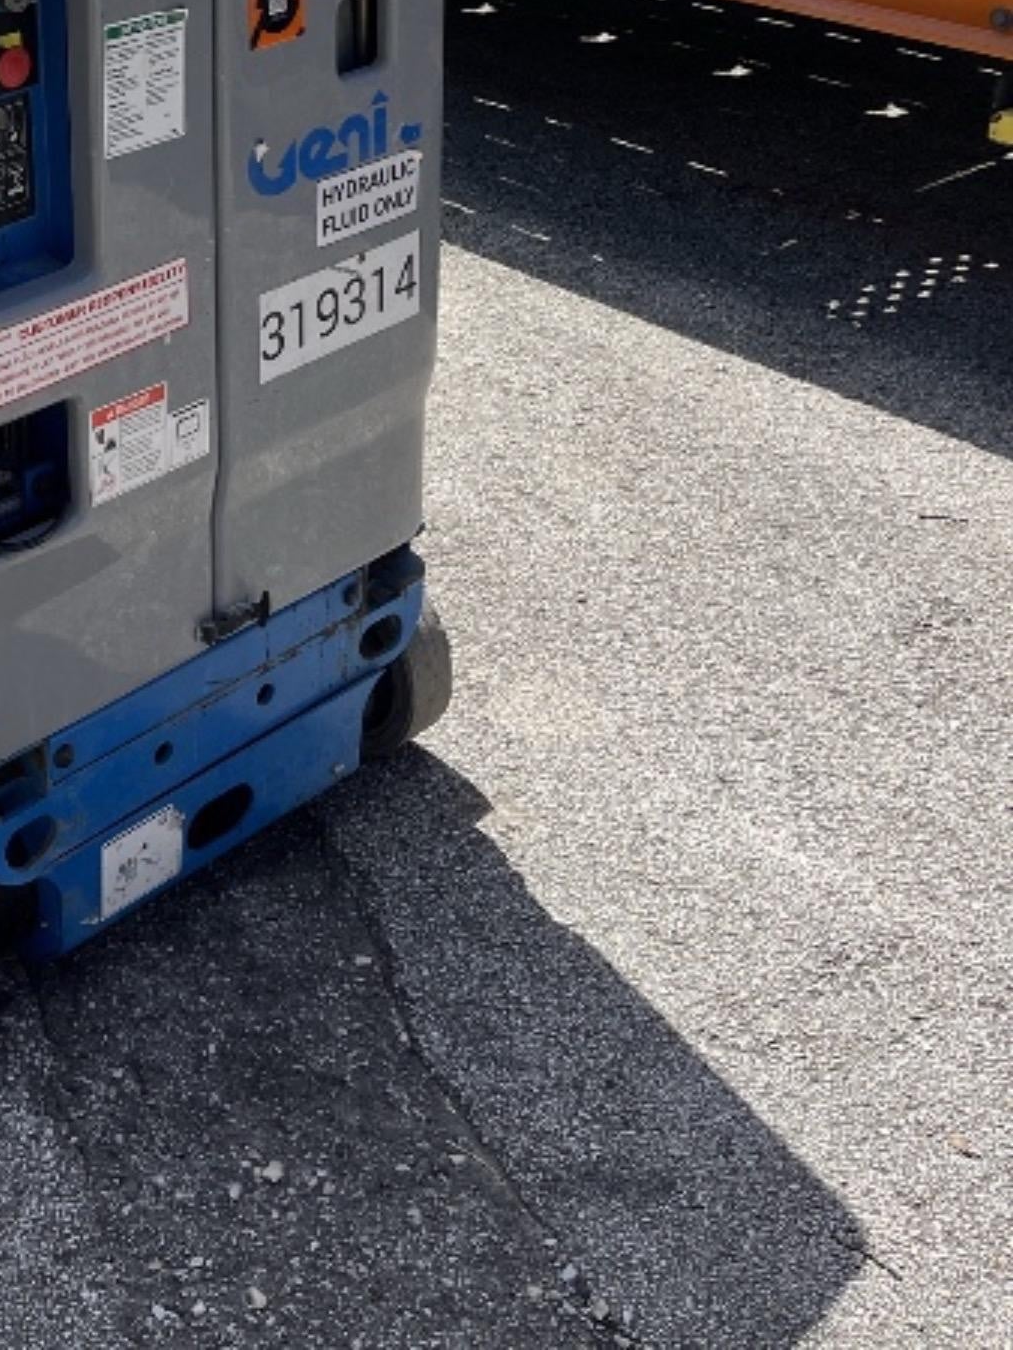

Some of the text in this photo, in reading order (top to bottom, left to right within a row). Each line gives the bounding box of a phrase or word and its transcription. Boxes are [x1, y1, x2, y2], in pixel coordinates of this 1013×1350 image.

[320, 155, 417, 209] HYDRAULIC
[321, 185, 416, 238] FLUID ONLY
[260, 253, 418, 362] 319314
